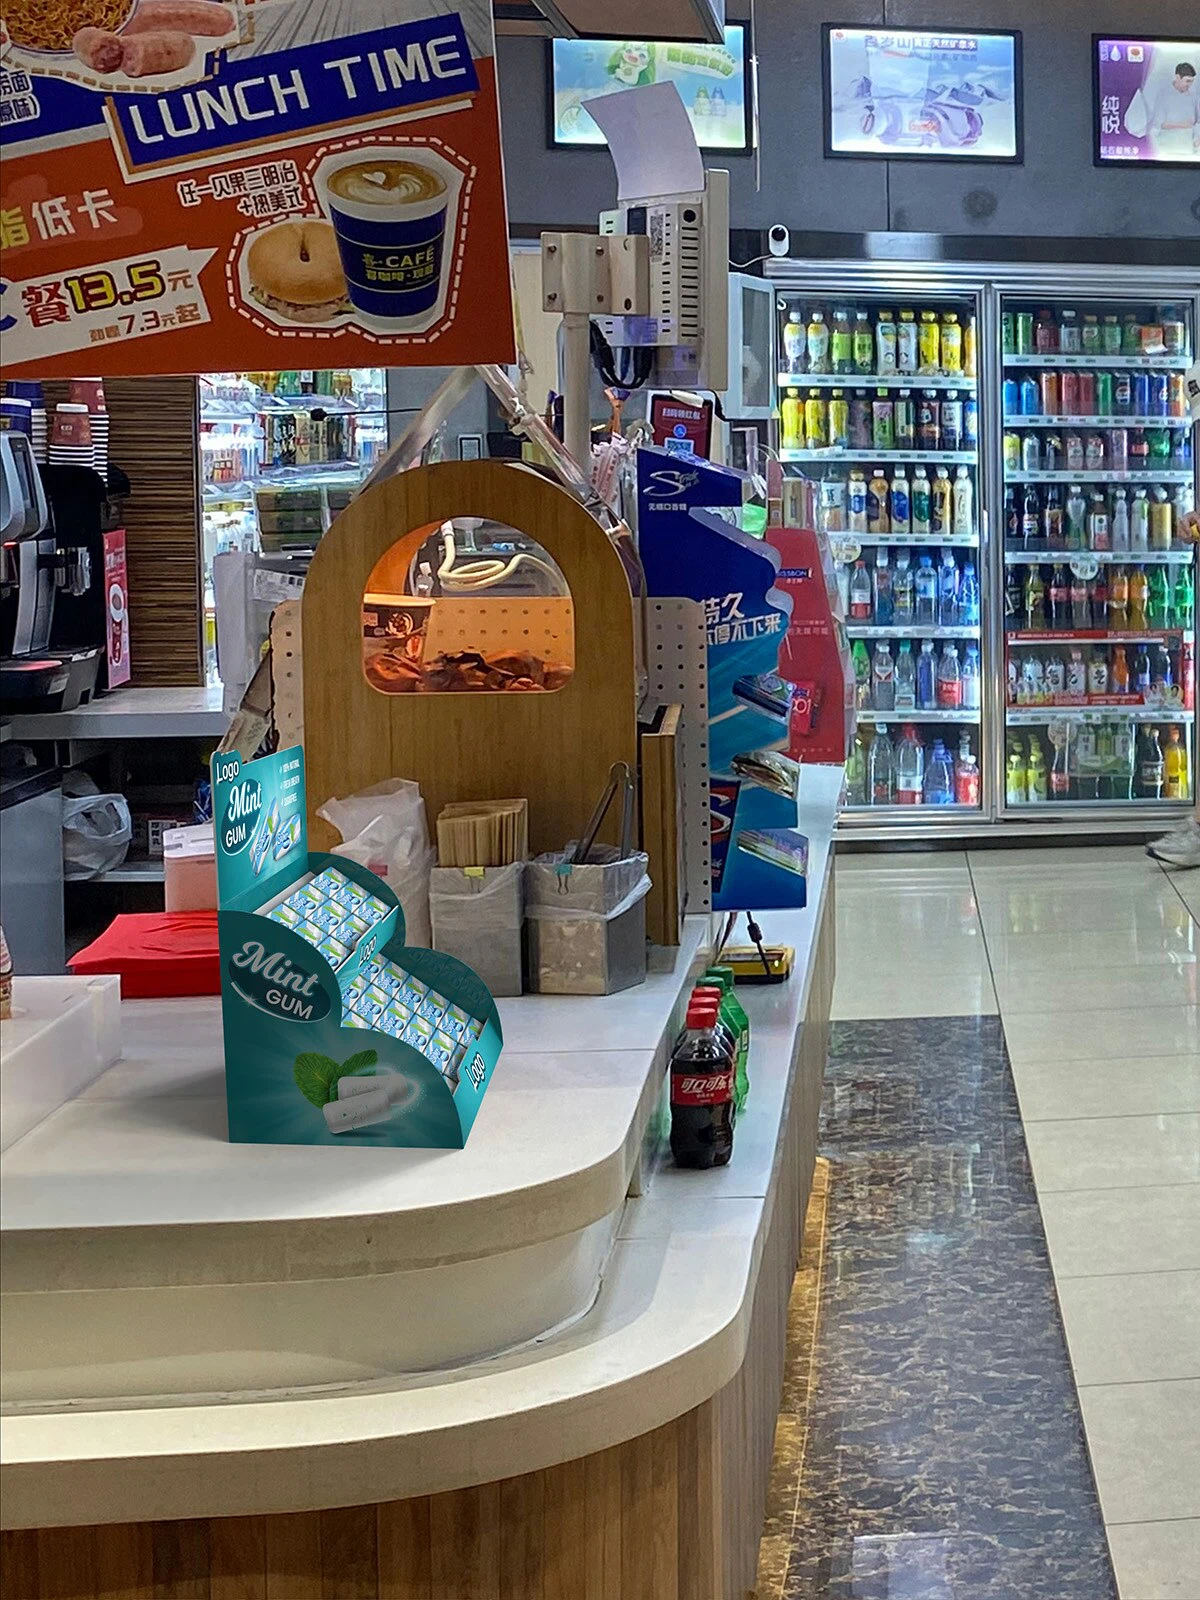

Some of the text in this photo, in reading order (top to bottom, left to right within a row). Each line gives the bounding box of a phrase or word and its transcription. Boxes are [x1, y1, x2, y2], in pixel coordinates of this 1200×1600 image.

[128, 34, 467, 145] LUNCH TIME
[1102, 95, 1120, 134] 纯悦
[179, 161, 298, 205] 任一贝果三明治
[216, 761, 239, 784] Logo
[228, 781, 262, 822] Mint
[225, 824, 246, 847] GUM
[232, 941, 319, 997] Mint
[265, 988, 314, 1020] GUM
[465, 1052, 485, 1091] Logo
[680, 1074, 730, 1094] 可口可乐
